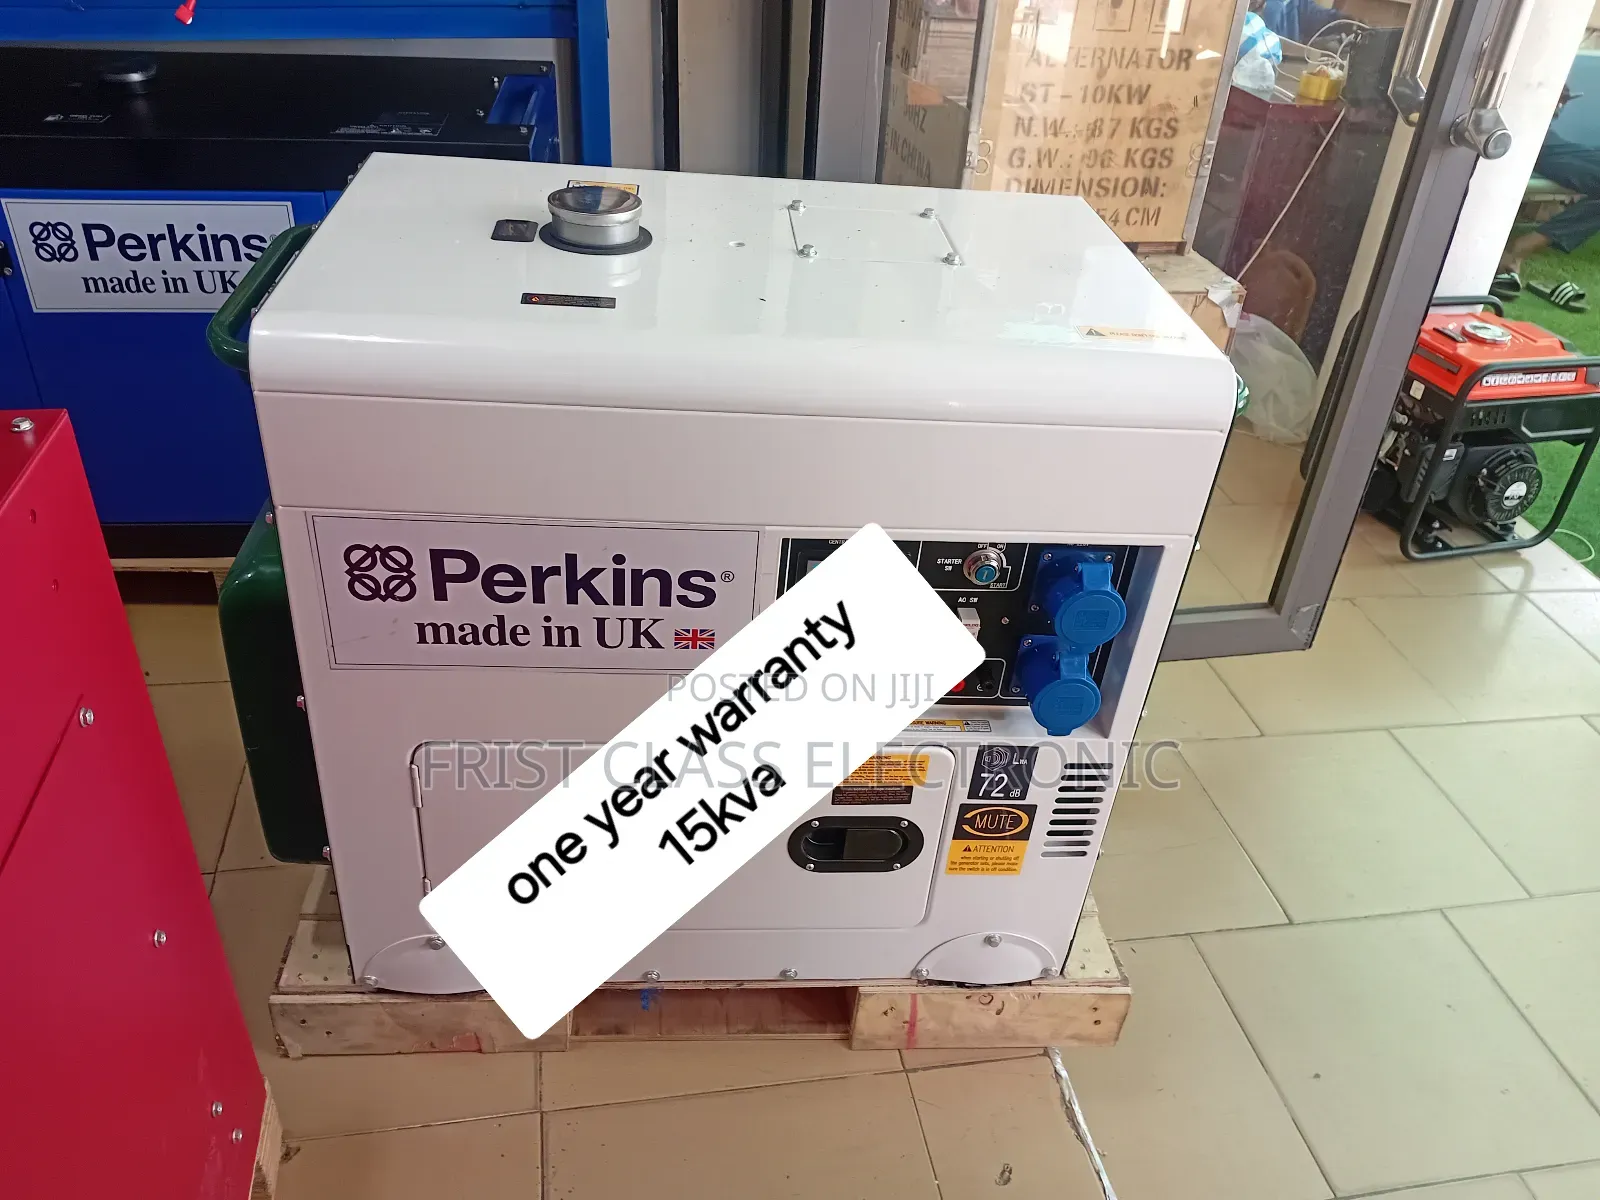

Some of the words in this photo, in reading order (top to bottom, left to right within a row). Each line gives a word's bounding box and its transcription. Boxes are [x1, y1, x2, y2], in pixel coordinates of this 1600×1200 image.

[1129, 116, 1179, 140] KGS
[900, 137, 931, 186] CHINA
[1124, 147, 1174, 169] KGS
[81, 223, 268, 262] Perkins
[81, 269, 157, 294] made
[161, 269, 190, 294] in
[193, 269, 241, 294] UK
[414, 614, 531, 647] made
[541, 615, 582, 648] in
[592, 617, 665, 650] UK
[978, 773, 1009, 798] 72
[1009, 788, 1022, 798] dB
[974, 814, 1018, 830] MUTE
[972, 845, 1015, 853] ATTENTION
